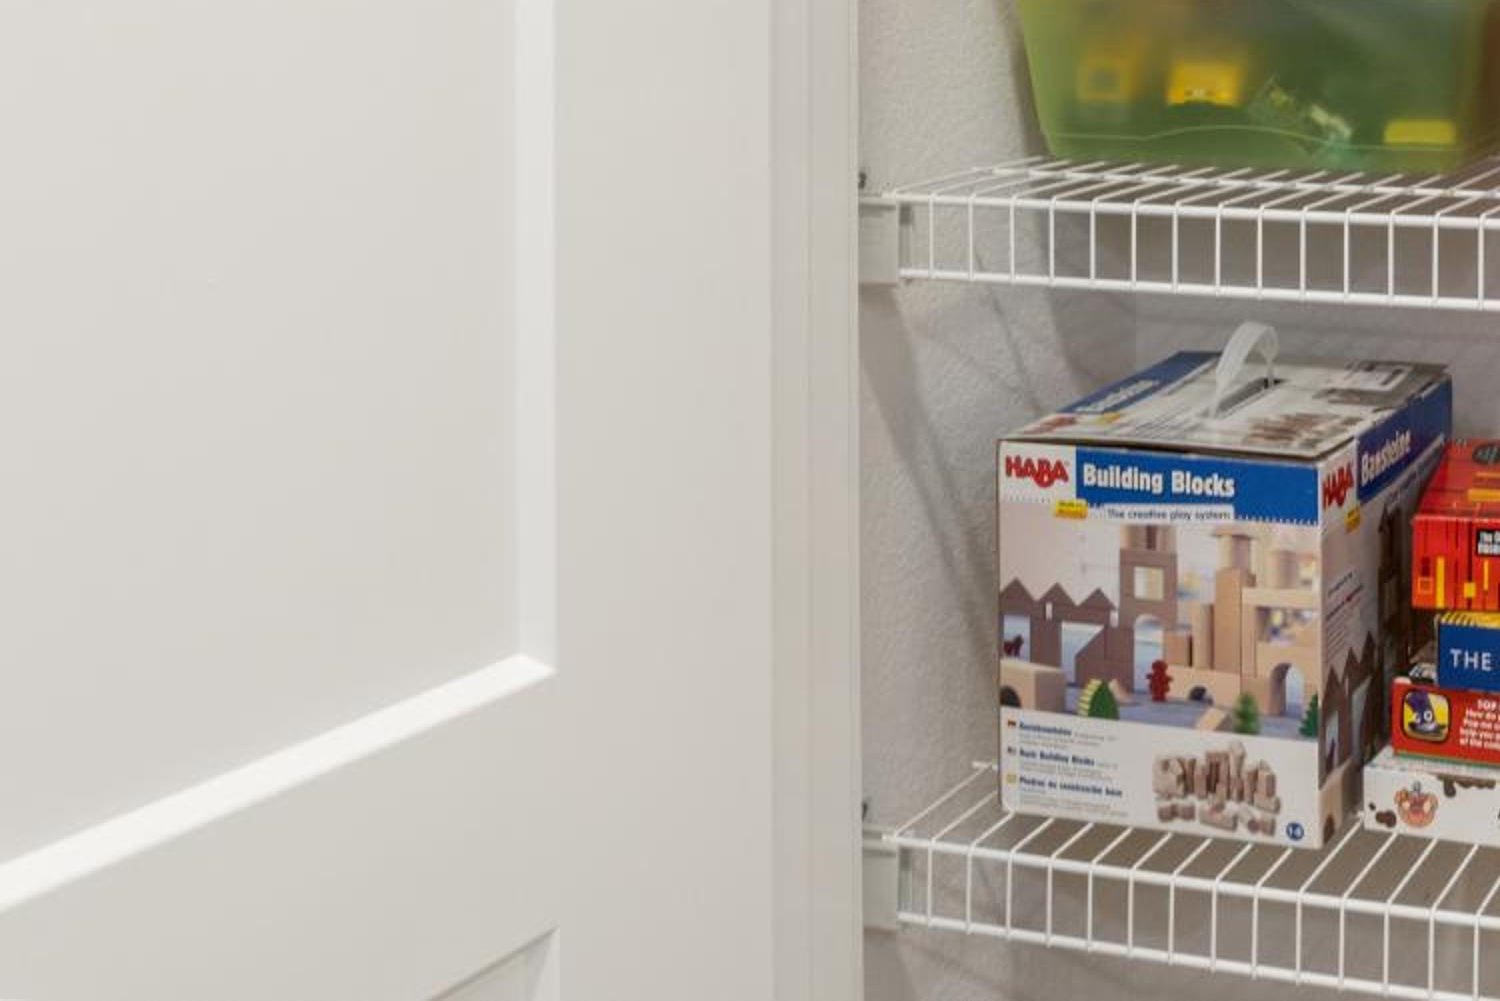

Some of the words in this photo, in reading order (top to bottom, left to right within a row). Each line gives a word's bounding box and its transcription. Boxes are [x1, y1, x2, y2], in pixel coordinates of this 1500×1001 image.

[1005, 455, 1069, 488] HABA
[1083, 463, 1164, 495] Building
[1171, 470, 1236, 497] Blocks
[1107, 507, 1125, 519] The
[1169, 510, 1191, 521] play
[1450, 649, 1492, 672] THE
[1477, 699, 1497, 711] TOP
